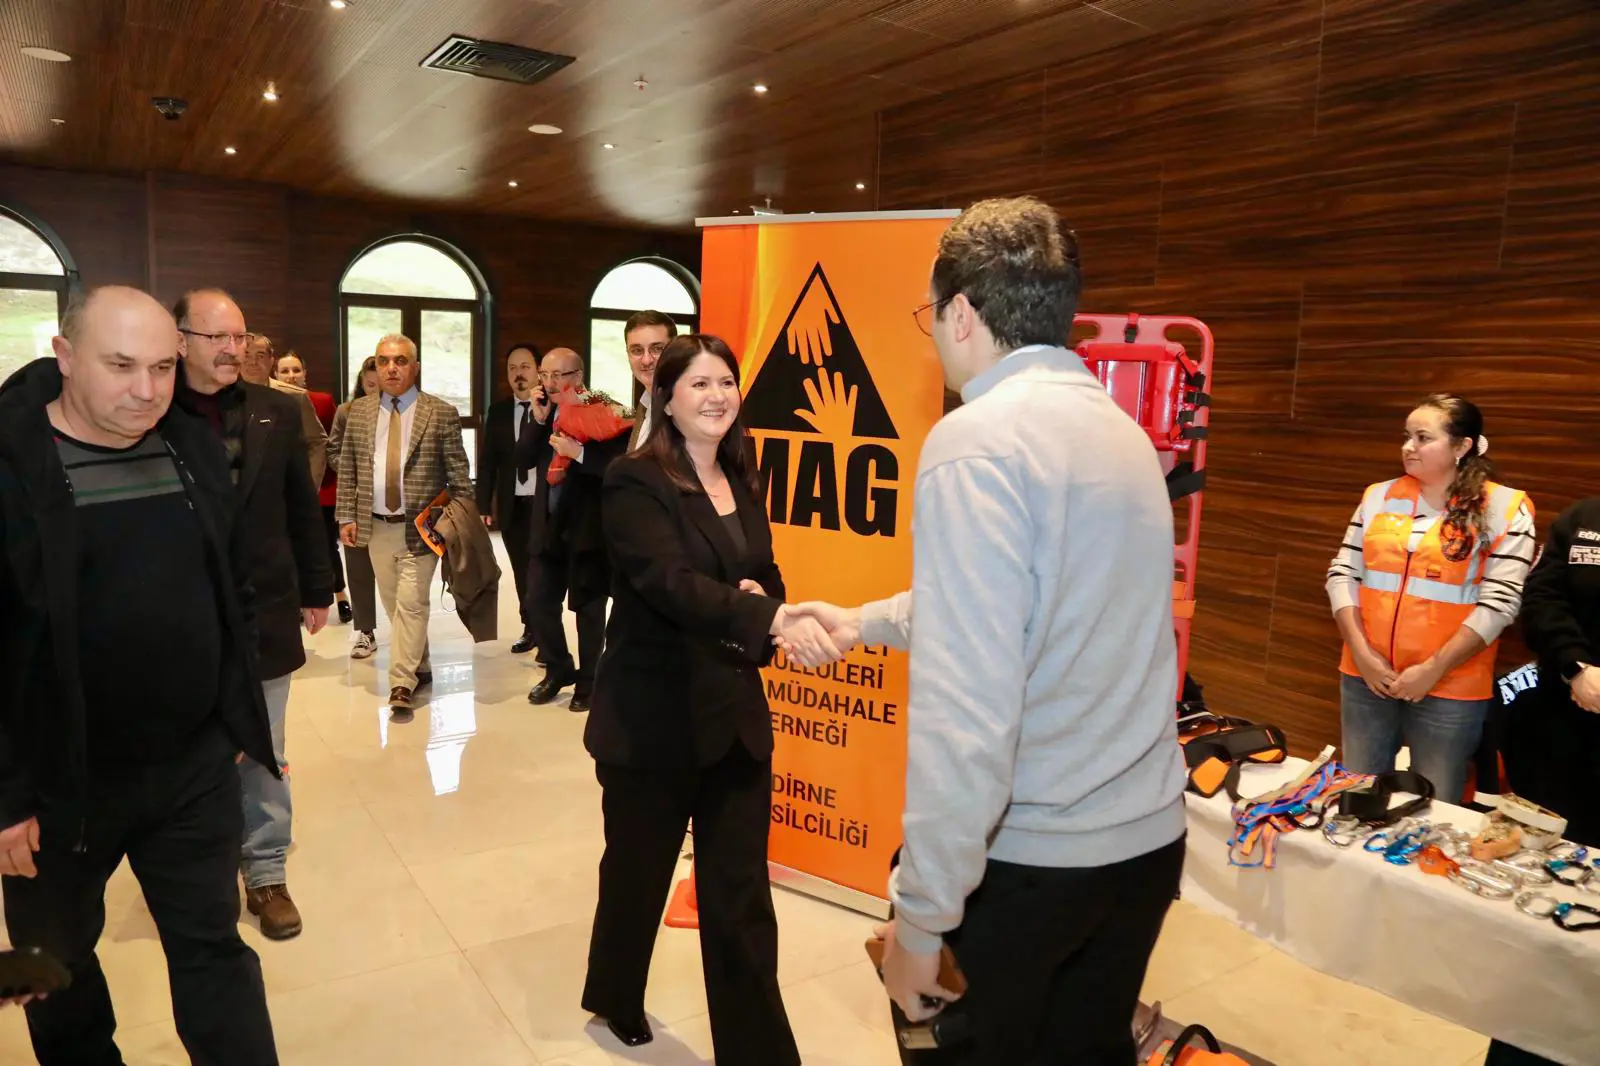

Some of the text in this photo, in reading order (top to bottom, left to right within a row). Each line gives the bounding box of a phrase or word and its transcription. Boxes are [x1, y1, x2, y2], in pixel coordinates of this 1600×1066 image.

[767, 679, 897, 725] MÜDAHALE
[772, 772, 837, 809] DİRNE
[771, 802, 869, 849] SİLCİLİĞİ
